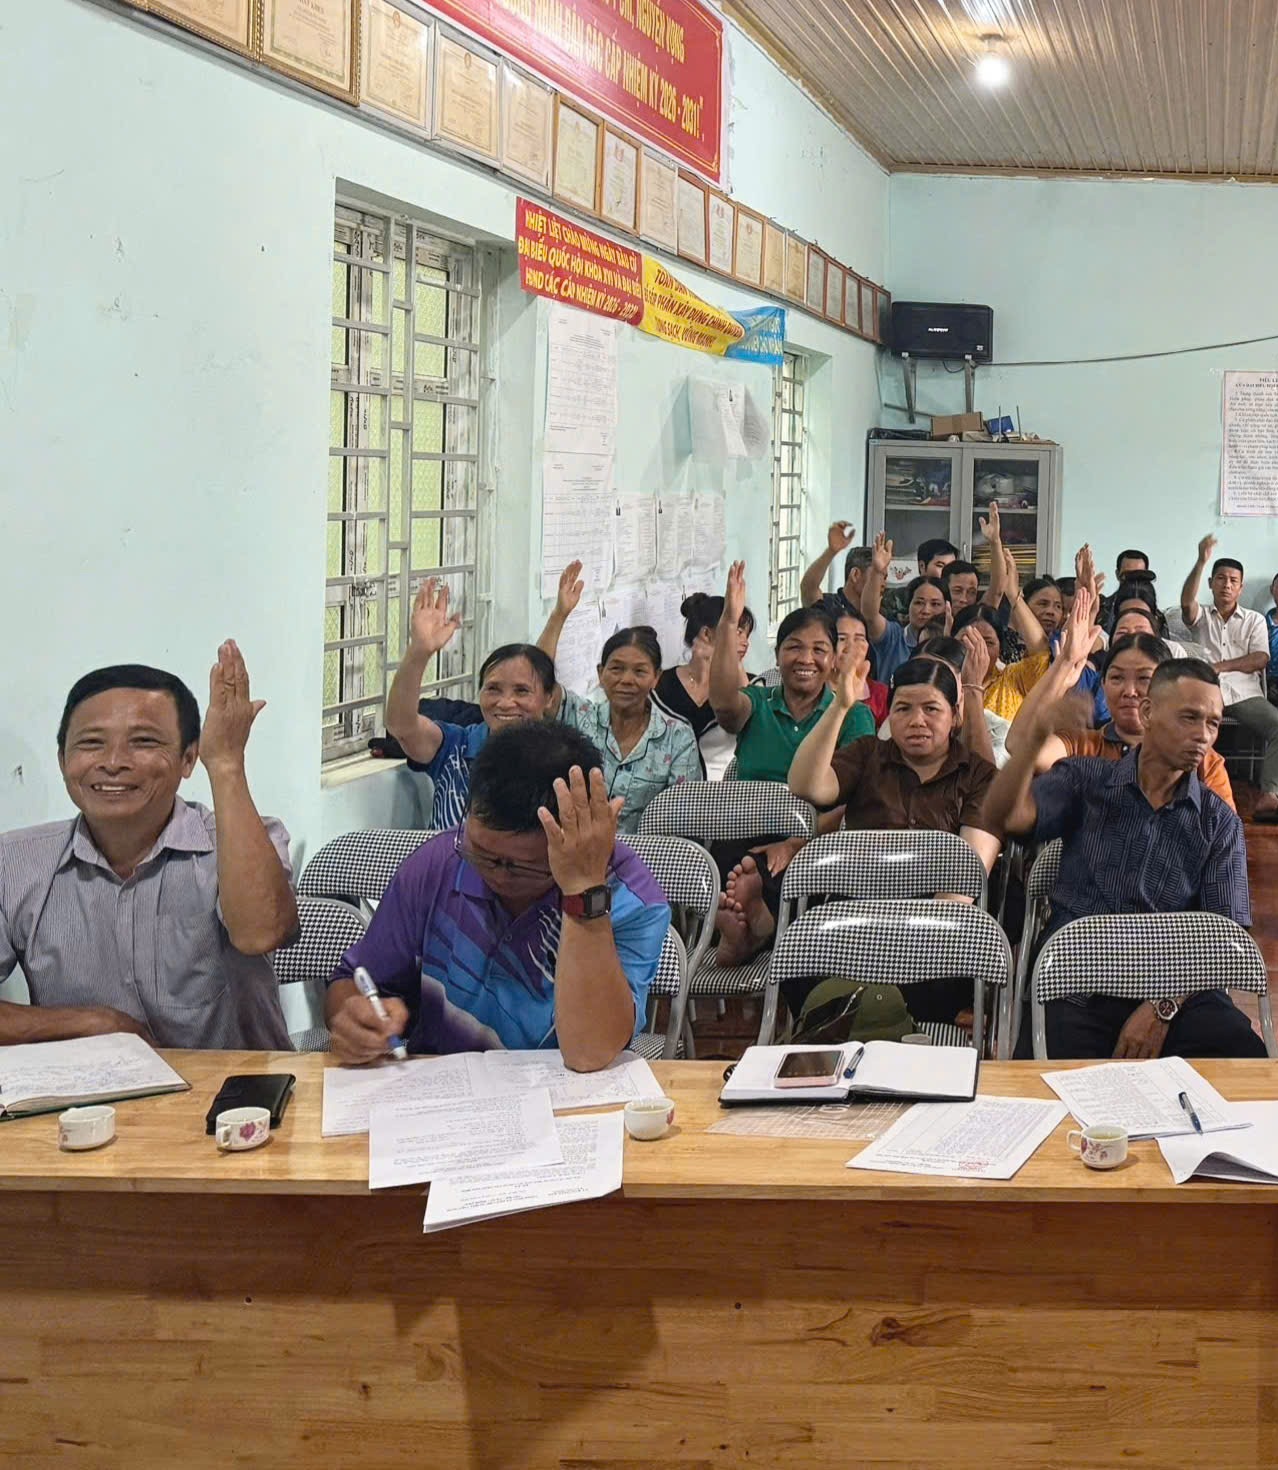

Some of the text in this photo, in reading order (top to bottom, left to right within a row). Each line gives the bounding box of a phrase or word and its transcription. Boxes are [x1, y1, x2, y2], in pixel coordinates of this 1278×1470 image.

[666, 17, 685, 64] VỌNG
[605, 28, 622, 85] CẤP
[623, 52, 649, 107] NHIỆM
[649, 64, 660, 112] KỲ
[660, 78, 677, 123] 2026
[525, 209, 547, 237] NHIỆT
[530, 236, 548, 263] BIỂU
[548, 245, 570, 270] QUỐC
[570, 252, 584, 278] HỘI
